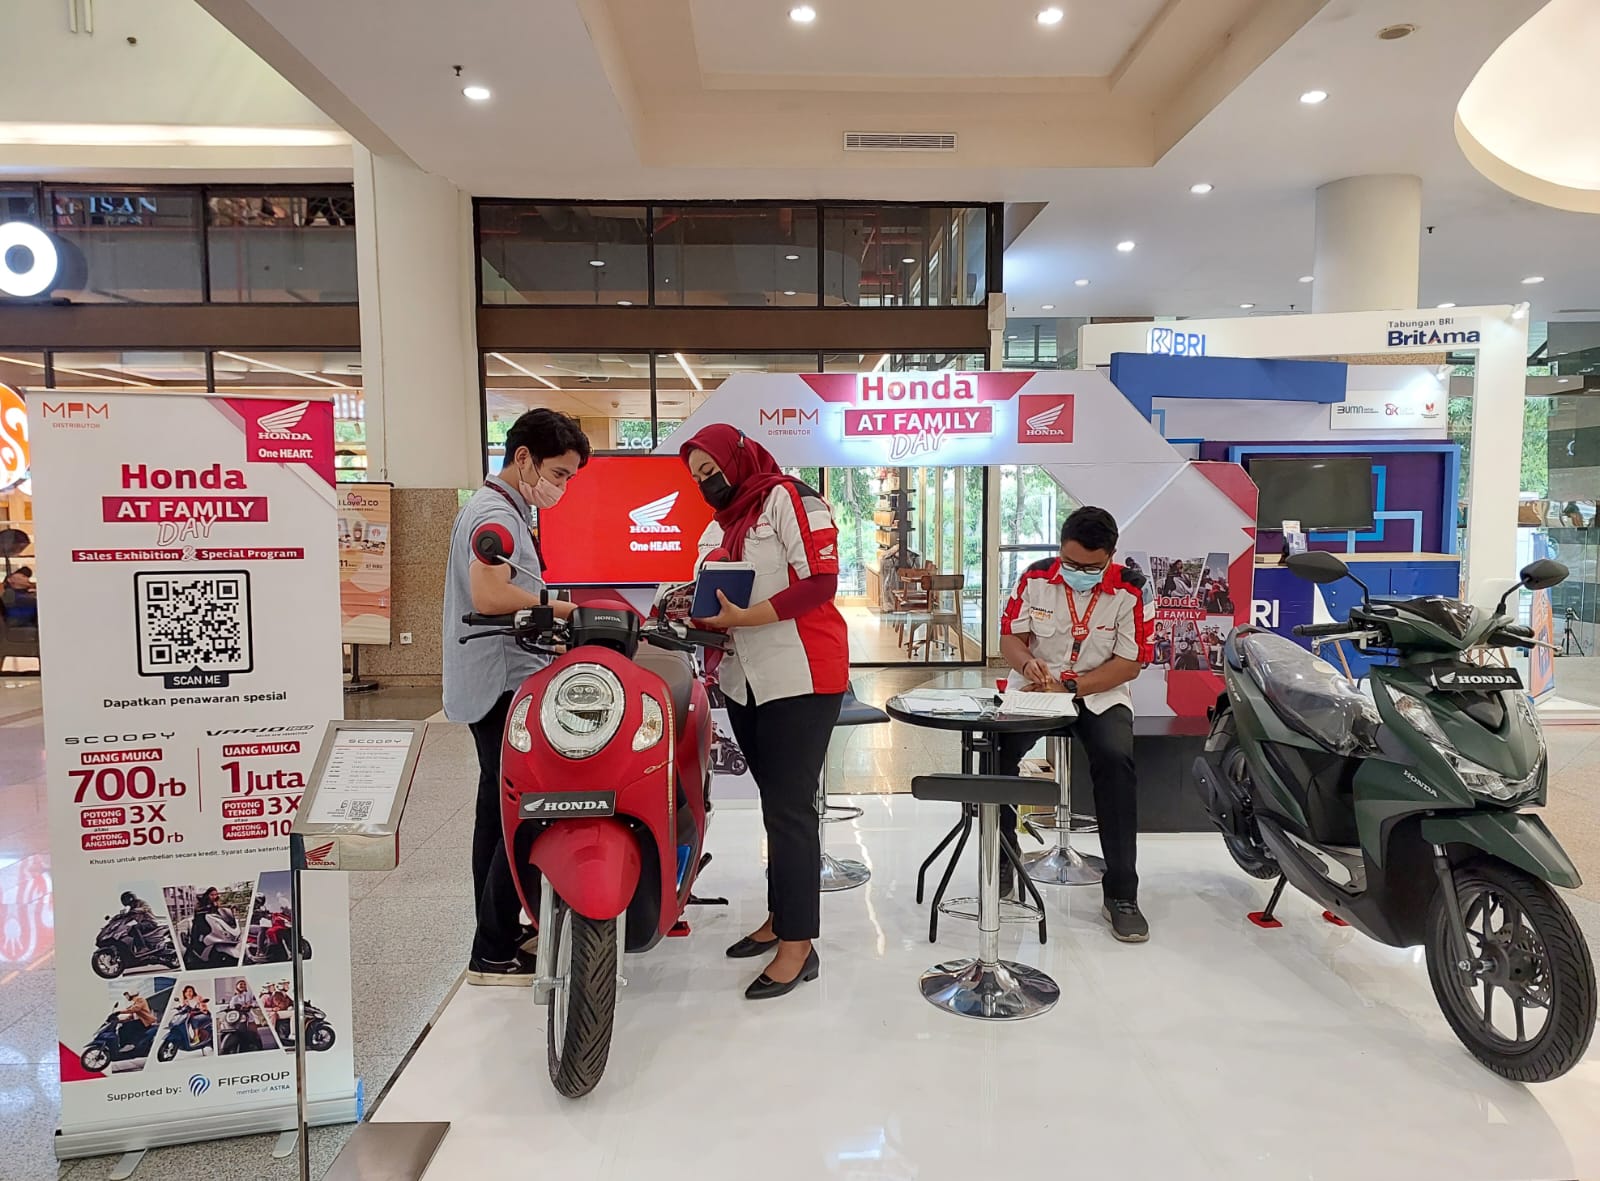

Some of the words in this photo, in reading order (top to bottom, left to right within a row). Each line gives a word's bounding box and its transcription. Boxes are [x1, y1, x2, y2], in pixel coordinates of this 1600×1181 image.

[1388, 320, 1435, 329] Tabungan
[1439, 318, 1454, 326] BRI
[1387, 328, 1480, 346] BritAma
[1173, 333, 1206, 356] BRI
[862, 375, 973, 401] Honda
[43, 402, 108, 419] MPM
[759, 408, 819, 425] MPM
[857, 414, 887, 431] AT
[894, 411, 980, 430] FAMILY
[258, 432, 312, 441] HONDA
[1026, 428, 1064, 436] HONDA
[890, 427, 945, 460] DAY
[258, 449, 278, 458] One
[280, 449, 314, 459] HEART.
[122, 463, 247, 490] Honda
[118, 501, 151, 518] AT
[160, 501, 254, 518] FAMILY
[157, 515, 217, 546] DAY
[629, 525, 681, 533] HONDA
[629, 541, 648, 551] One
[650, 541, 681, 551] HEART.
[78, 551, 112, 561] Sales
[115, 550, 178, 560] Exhibition
[181, 546, 198, 562] &
[202, 549, 244, 561] Special
[248, 549, 297, 561] Program
[1155, 610, 1162, 618] T
[1164, 610, 1201, 619] FAMILY
[1251, 599, 1280, 628] RI
[173, 675, 202, 686] SCAN
[205, 675, 221, 685] ME
[1458, 675, 1517, 684] HONDA
[104, 697, 166, 709] Dapatkan
[170, 694, 240, 707] penawaran
[243, 691, 286, 705] spesial
[65, 732, 175, 745] SCOOPY
[224, 746, 258, 756] UANG
[261, 744, 297, 754] MUKA
[83, 754, 119, 764] UANG
[122, 751, 160, 761] MUKA
[1403, 769, 1438, 798] HONDA
[224, 801, 260, 810] POTONG
[544, 800, 609, 811] HONDA
[83, 810, 122, 819] POTONG
[228, 808, 258, 816] TENOR
[86, 818, 119, 826] TENOR
[90, 833, 122, 841] POTONG
[226, 830, 266, 838] ANGSURAN
[85, 838, 128, 848] ANGSURAN
[138, 854, 174, 862] pembelian
[221, 849, 242, 857] Syarat
[218, 1071, 290, 1087] FIFGROUP
[106, 1087, 162, 1102] Supported
[165, 1085, 182, 1098] by:
[236, 1088, 260, 1096] member
[261, 1086, 268, 1094] of
[270, 1084, 290, 1092] ASTRA
